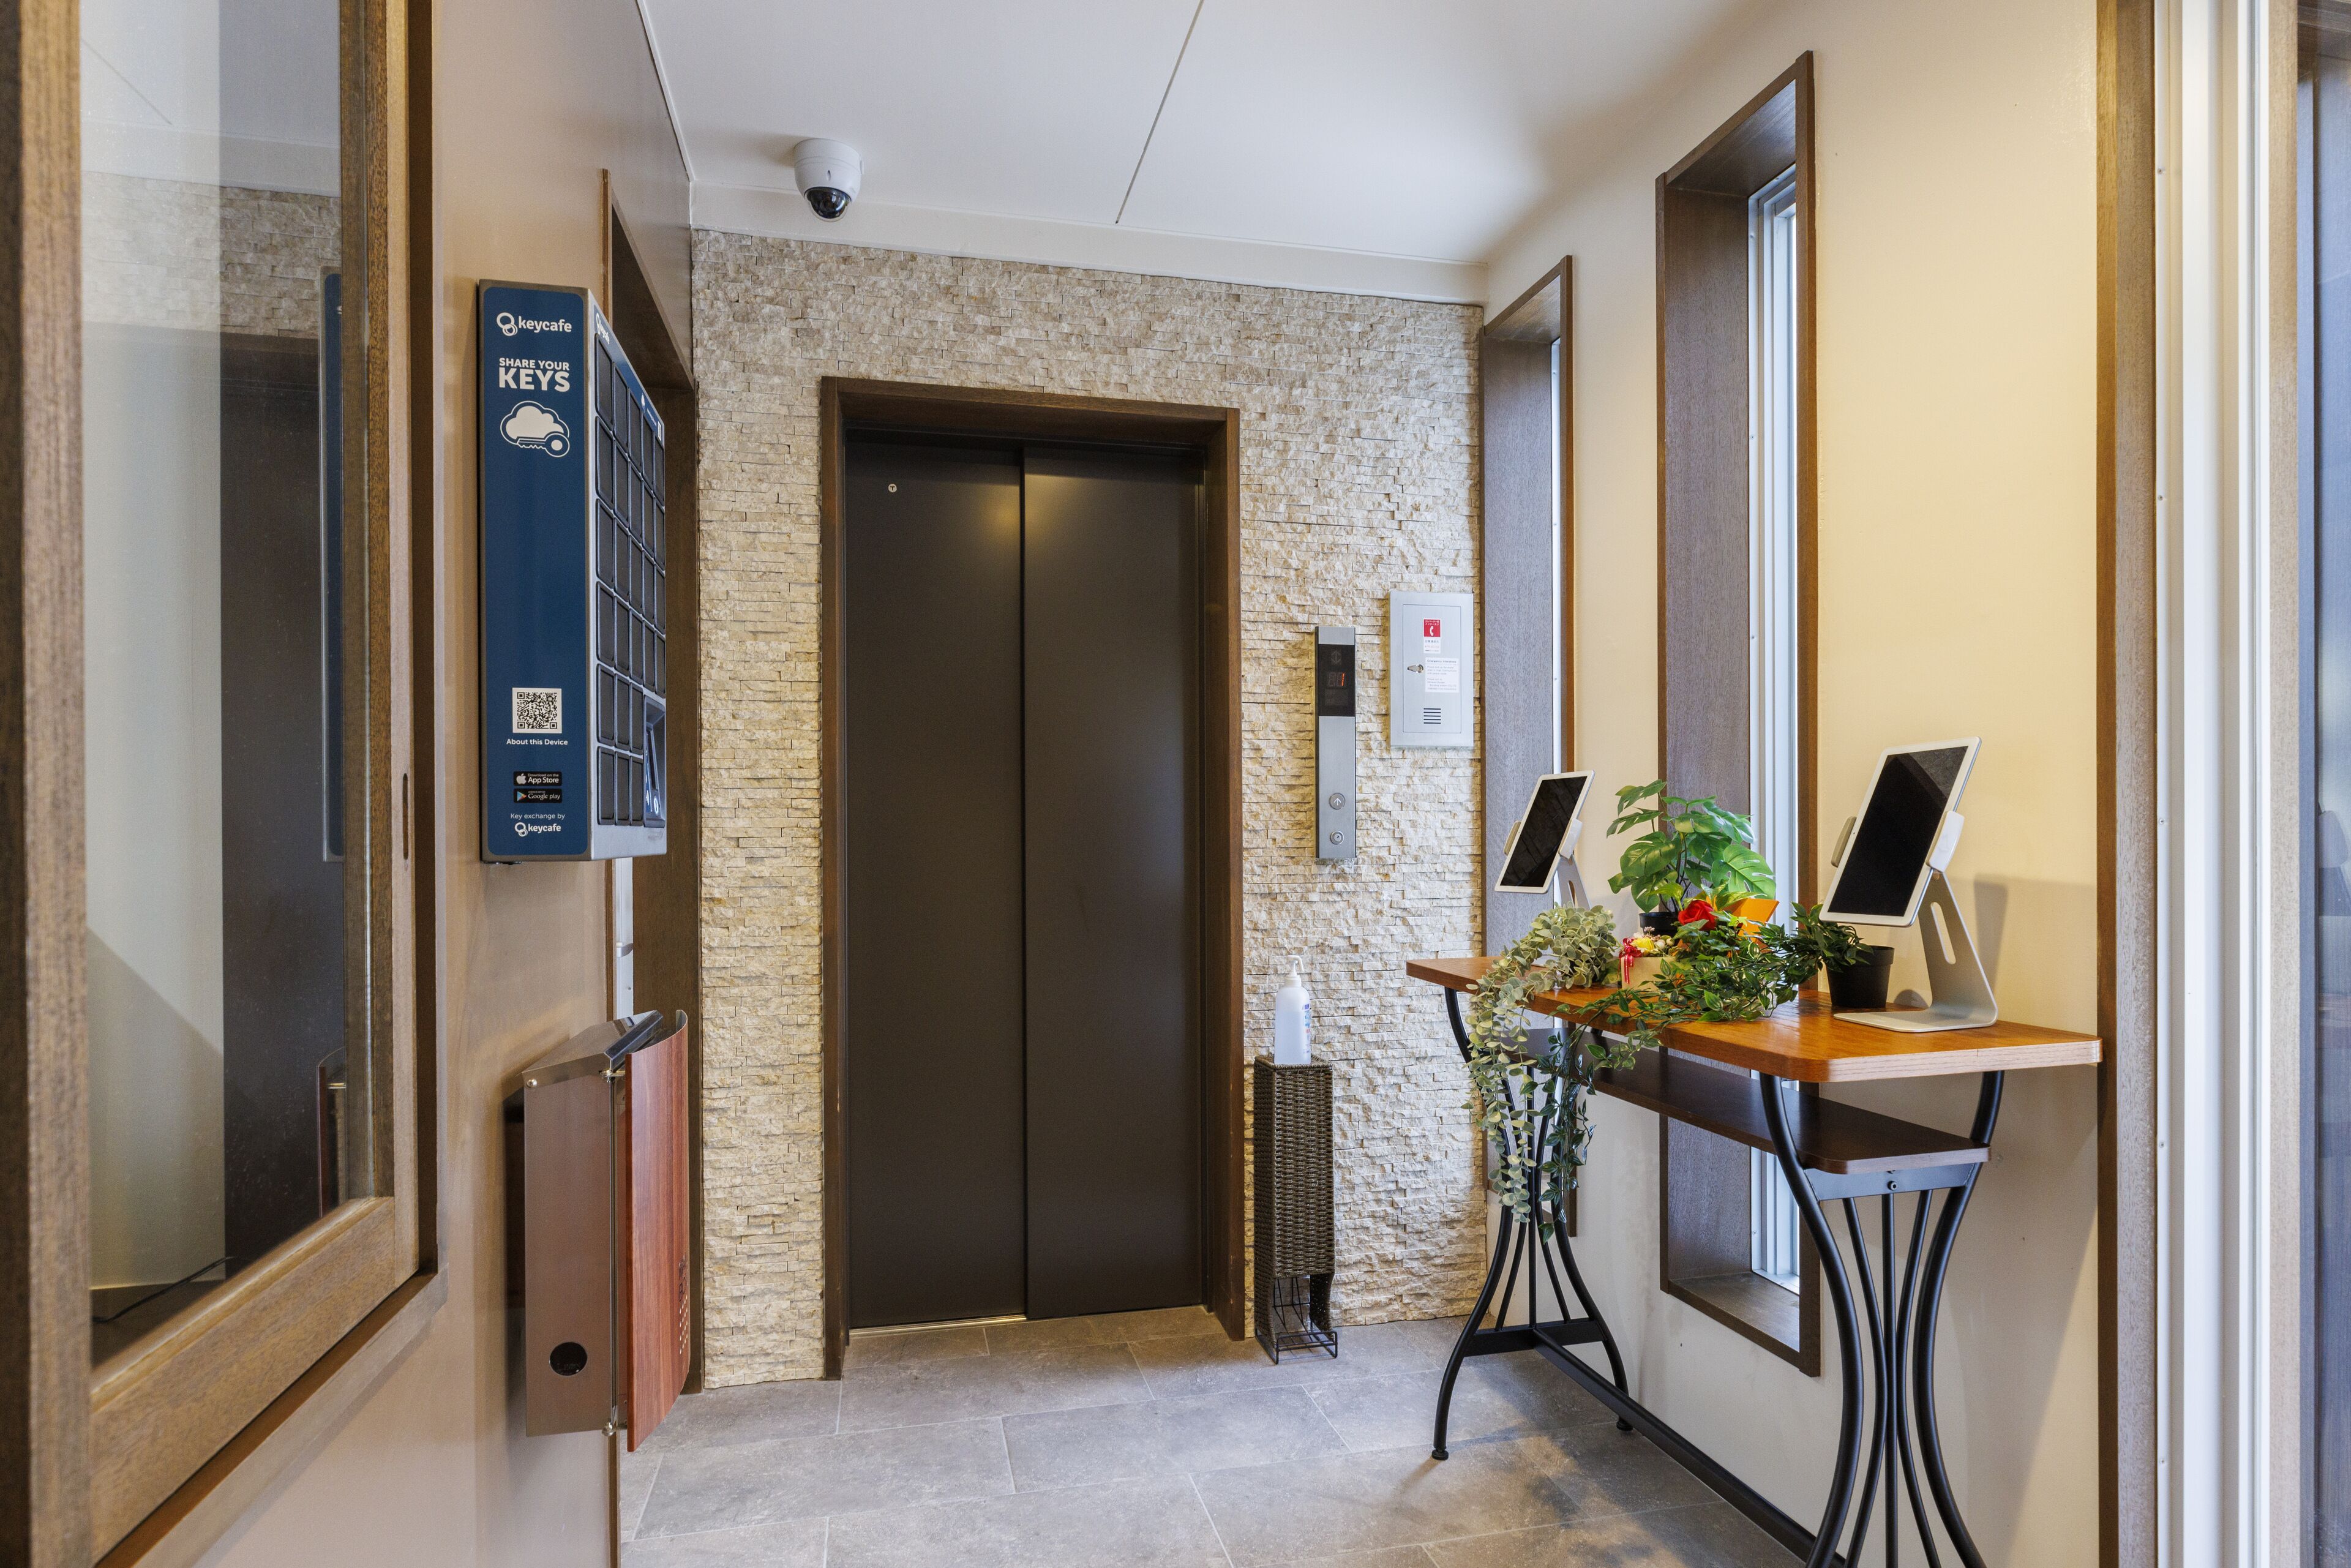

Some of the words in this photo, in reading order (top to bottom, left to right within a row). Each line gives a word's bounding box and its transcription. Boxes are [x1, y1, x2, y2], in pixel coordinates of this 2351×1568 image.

[518, 315, 572, 333] keycafe
[499, 357, 536, 369] SHARE
[538, 359, 570, 371] YOUR
[499, 367, 571, 392] KEYS
[528, 823, 561, 834] keycafe
